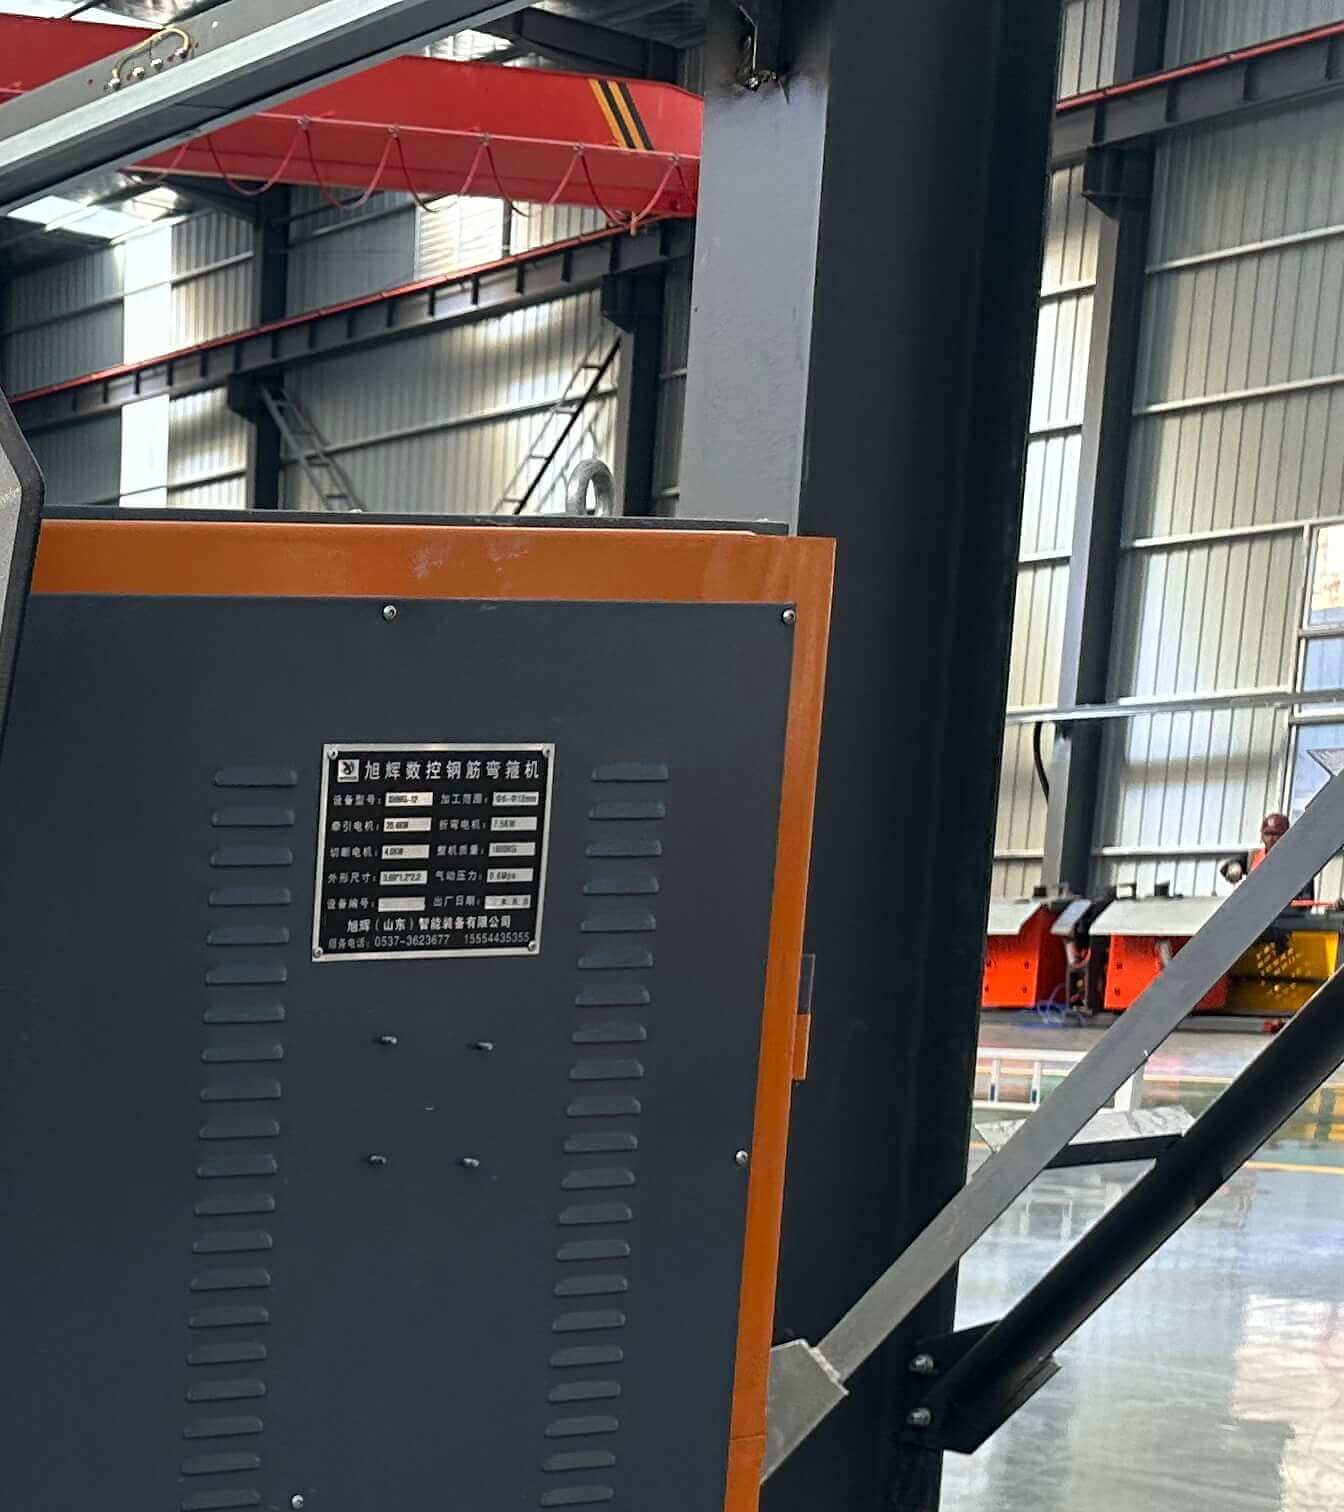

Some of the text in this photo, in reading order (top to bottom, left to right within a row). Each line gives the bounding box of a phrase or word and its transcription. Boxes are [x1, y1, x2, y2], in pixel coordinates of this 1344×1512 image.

[364, 760, 539, 780] 旭辉数控钢筋弯箍机
[463, 931, 530, 944] 15554435355
